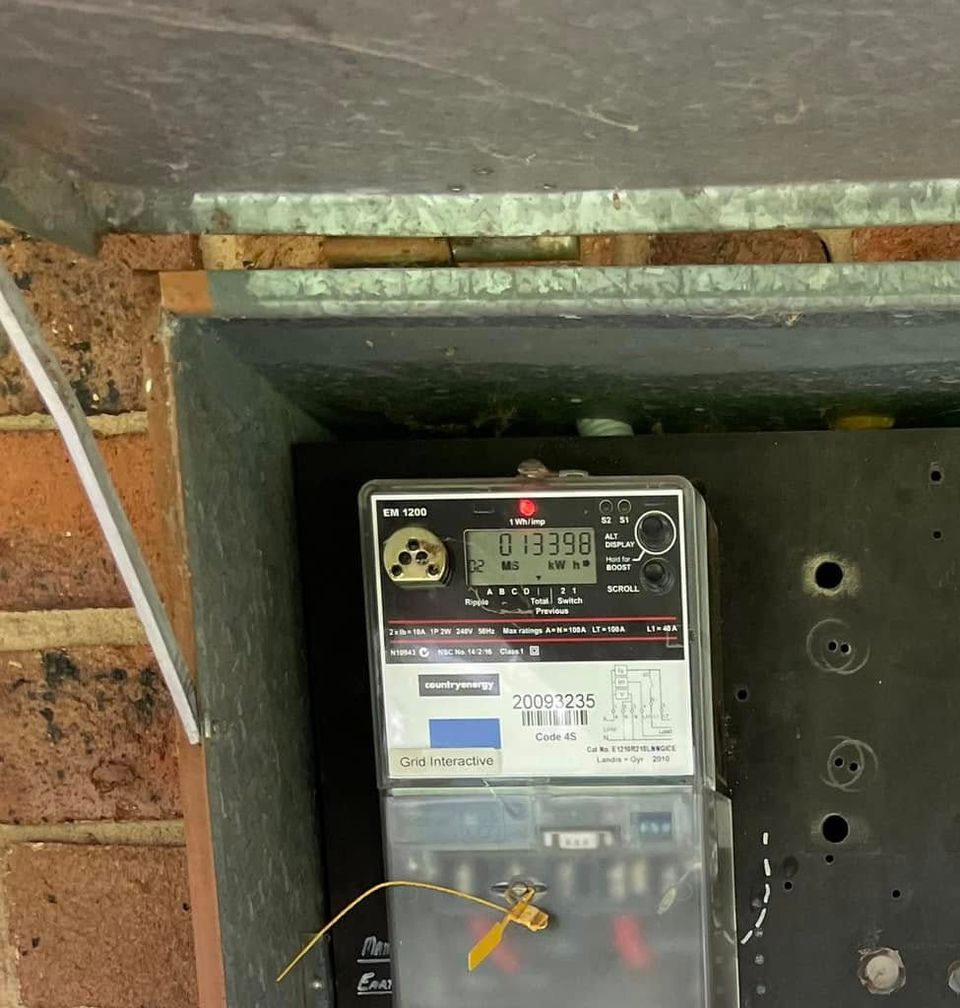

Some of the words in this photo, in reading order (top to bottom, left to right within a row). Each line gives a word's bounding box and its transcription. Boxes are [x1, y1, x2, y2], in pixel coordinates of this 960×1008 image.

[383, 508, 400, 517] EM
[402, 507, 427, 517] 1200
[601, 516, 612, 525] S2
[619, 515, 629, 524] S1
[499, 532, 592, 556] 013398
[604, 541, 635, 549] DISPLAY
[607, 585, 640, 593] SCROLL
[465, 599, 489, 607] Ripple
[557, 596, 583, 604] Switch
[535, 607, 569, 616] Previous
[502, 627, 517, 635] Max
[518, 627, 543, 636] ratings
[424, 680, 495, 691] countryenergy
[512, 694, 596, 710] 20093235
[535, 732, 560, 742] Code
[563, 732, 577, 741] 4S
[400, 756, 426, 768] Grid
[430, 755, 494, 767] Interactive
